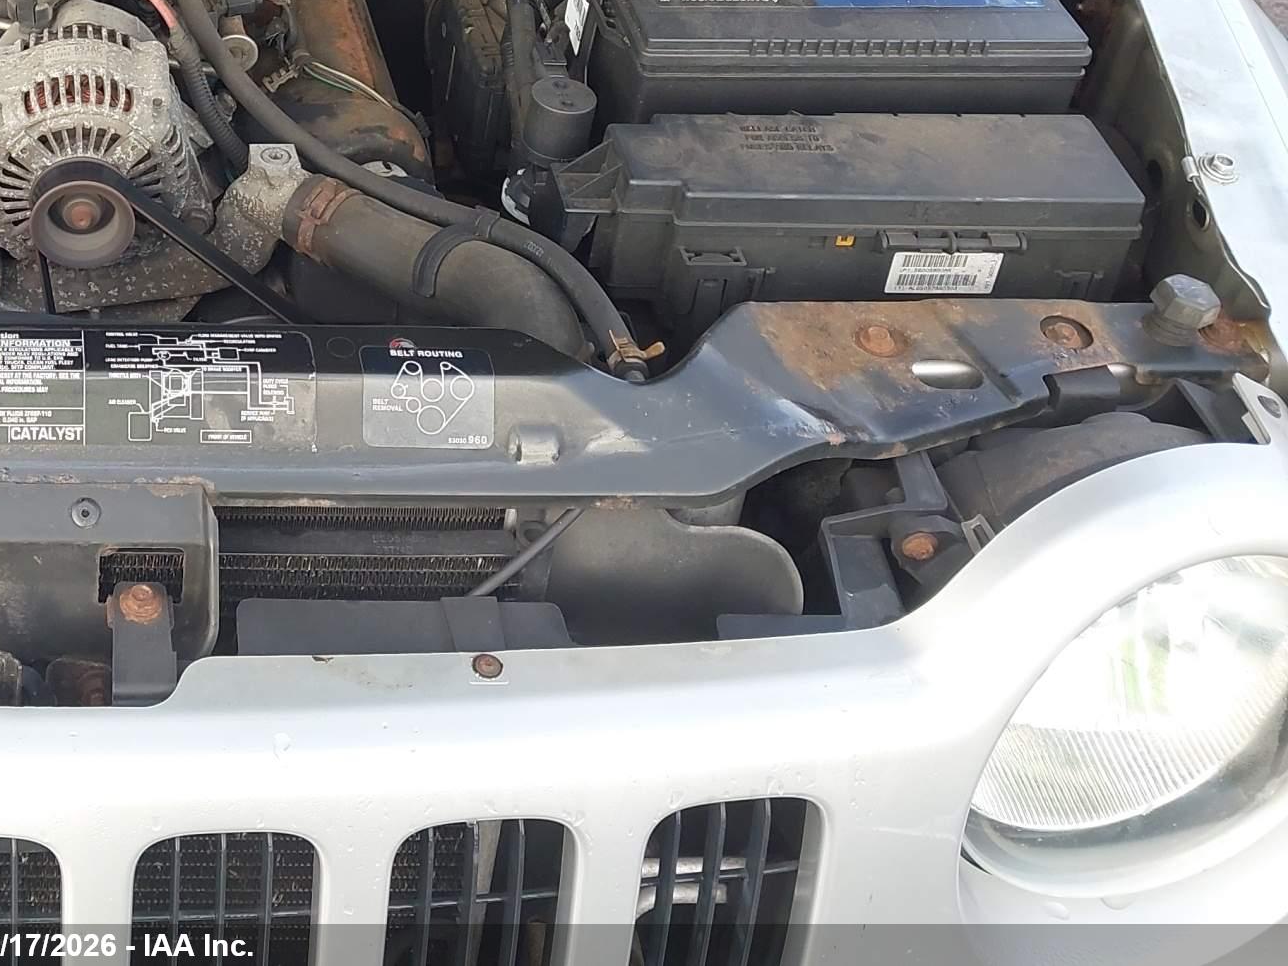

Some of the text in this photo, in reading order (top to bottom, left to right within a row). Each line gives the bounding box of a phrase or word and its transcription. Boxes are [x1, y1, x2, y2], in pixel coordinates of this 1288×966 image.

[389, 349, 464, 359] BELT ROUTING
[372, 404, 404, 412] REMOVAL
[10, 427, 83, 441] CATALYST
[467, 435, 488, 445] 960
